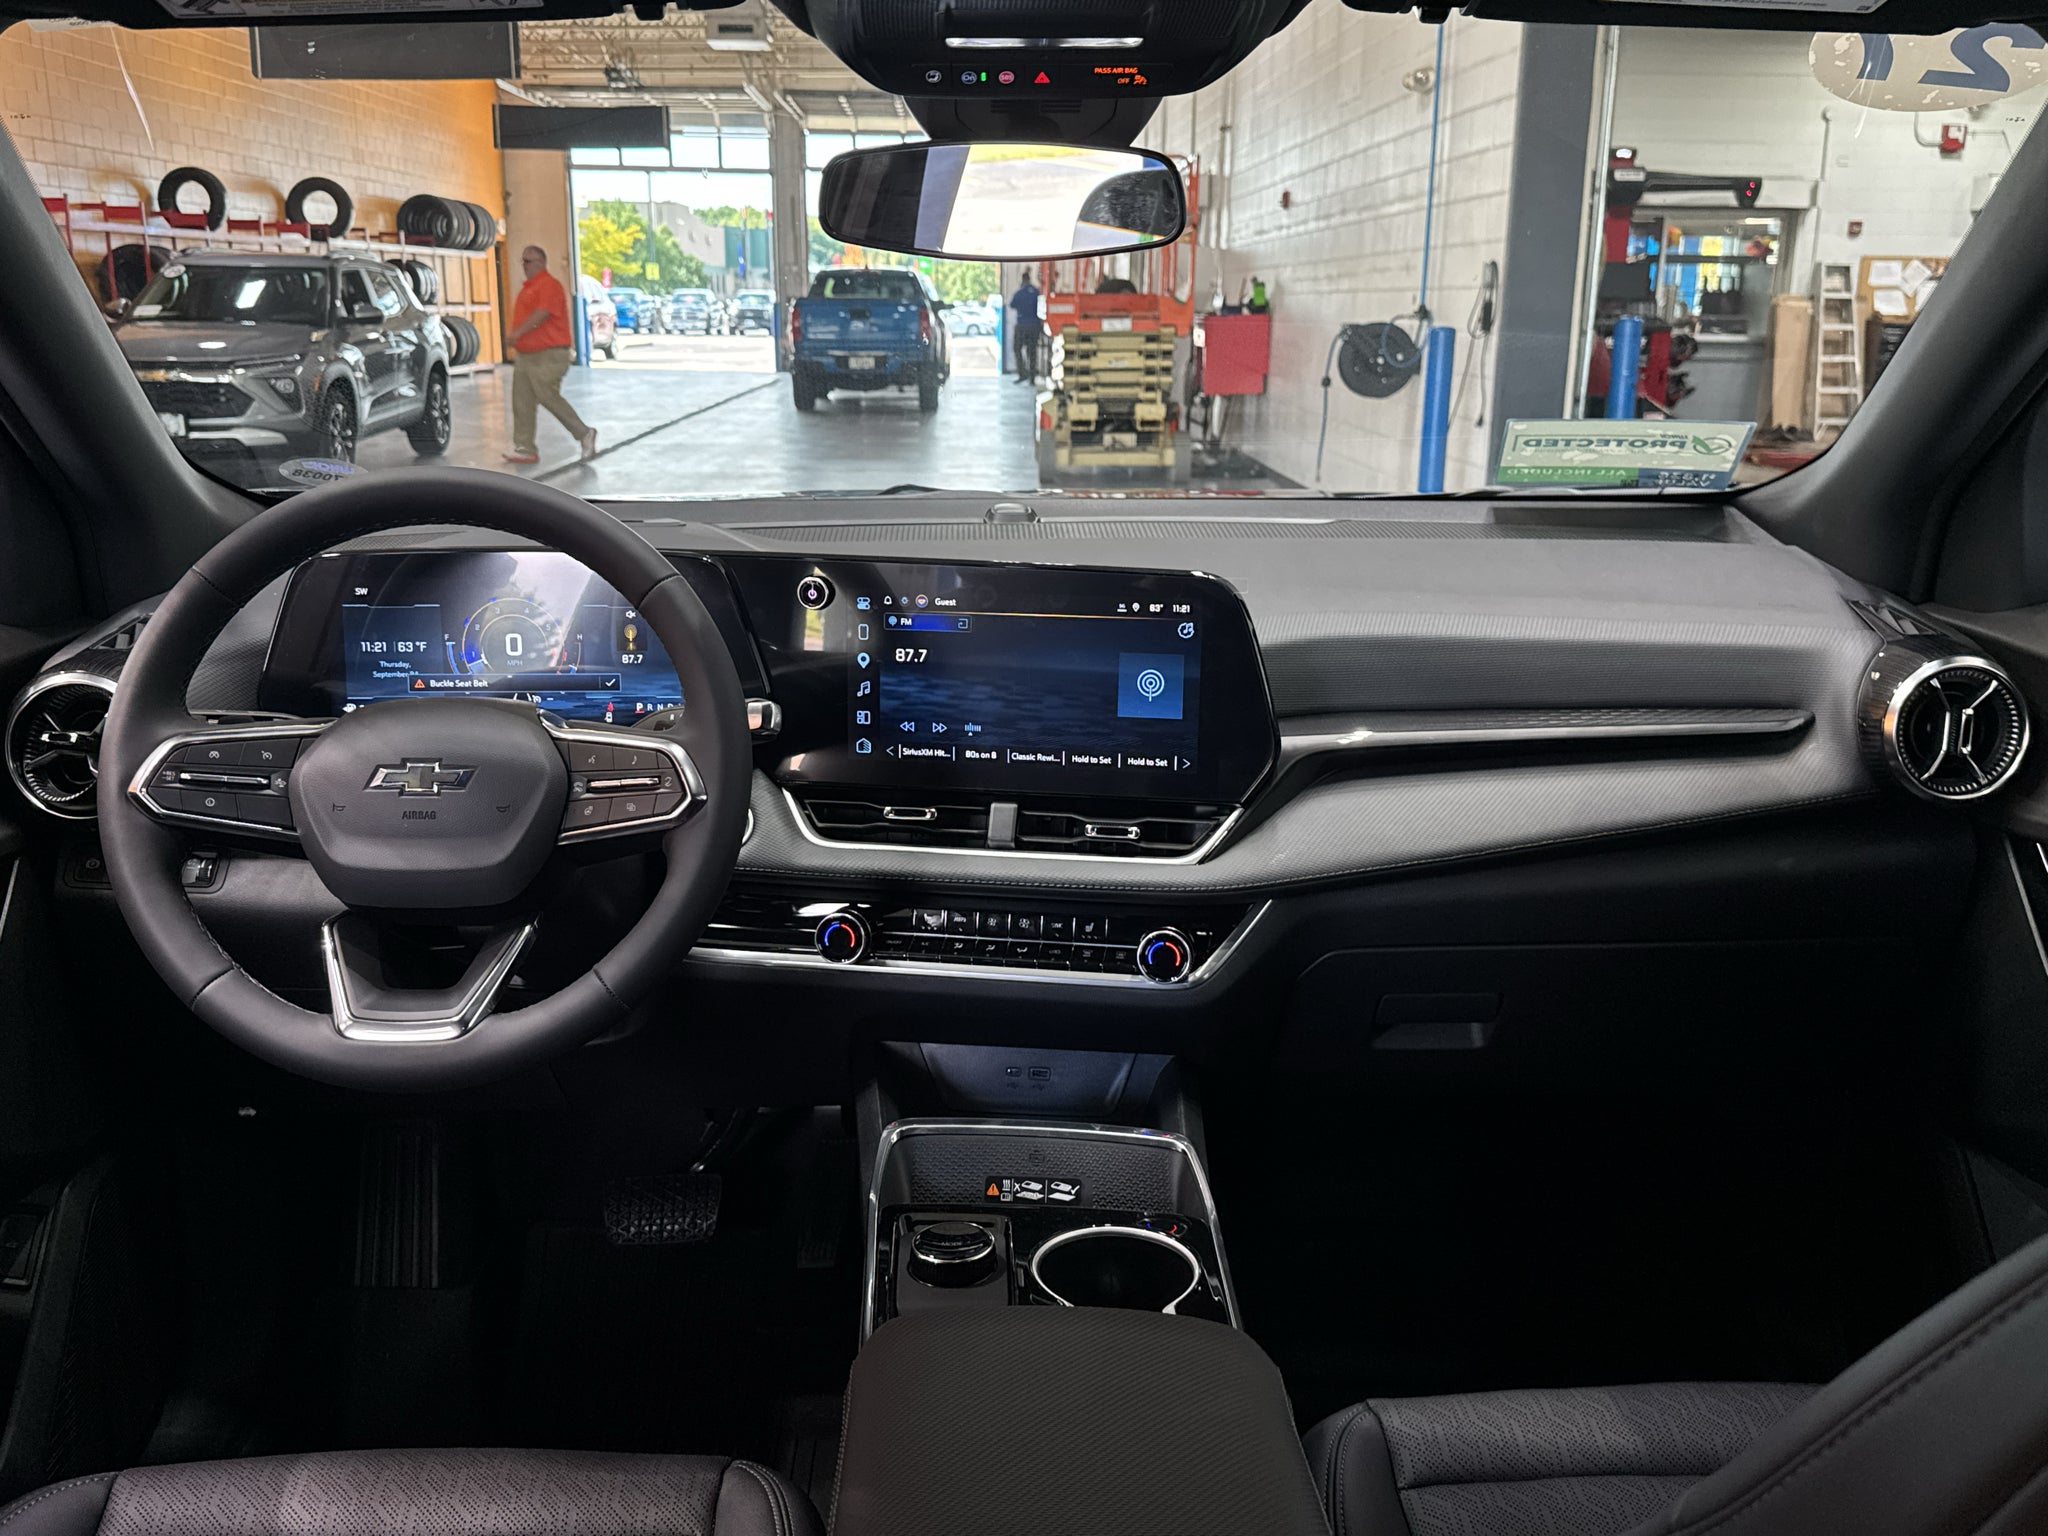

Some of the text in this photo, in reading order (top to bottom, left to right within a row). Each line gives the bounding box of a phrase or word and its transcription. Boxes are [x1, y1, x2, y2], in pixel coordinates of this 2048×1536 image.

[354, 587, 369, 596] SW
[934, 597, 957, 606] Guest
[1172, 604, 1191, 613] 11:21
[900, 618, 912, 626] FM
[360, 641, 387, 653] 11:21
[397, 641, 428, 653] 63 °F
[505, 633, 523, 656] 0
[621, 654, 643, 664] 87.7
[895, 648, 928, 662] 87.7
[379, 661, 412, 669] Thursday,
[372, 671, 408, 679] September
[430, 680, 488, 688] Buckle Seat Belt
[636, 702, 644, 711] P
[902, 747, 933, 756] SiriusXM
[1011, 752, 1036, 761] Classic
[1071, 755, 1089, 763] Hold
[1099, 756, 1112, 764] Set
[1127, 757, 1168, 767] Hold to Set
[402, 811, 437, 820] AIRBAG
